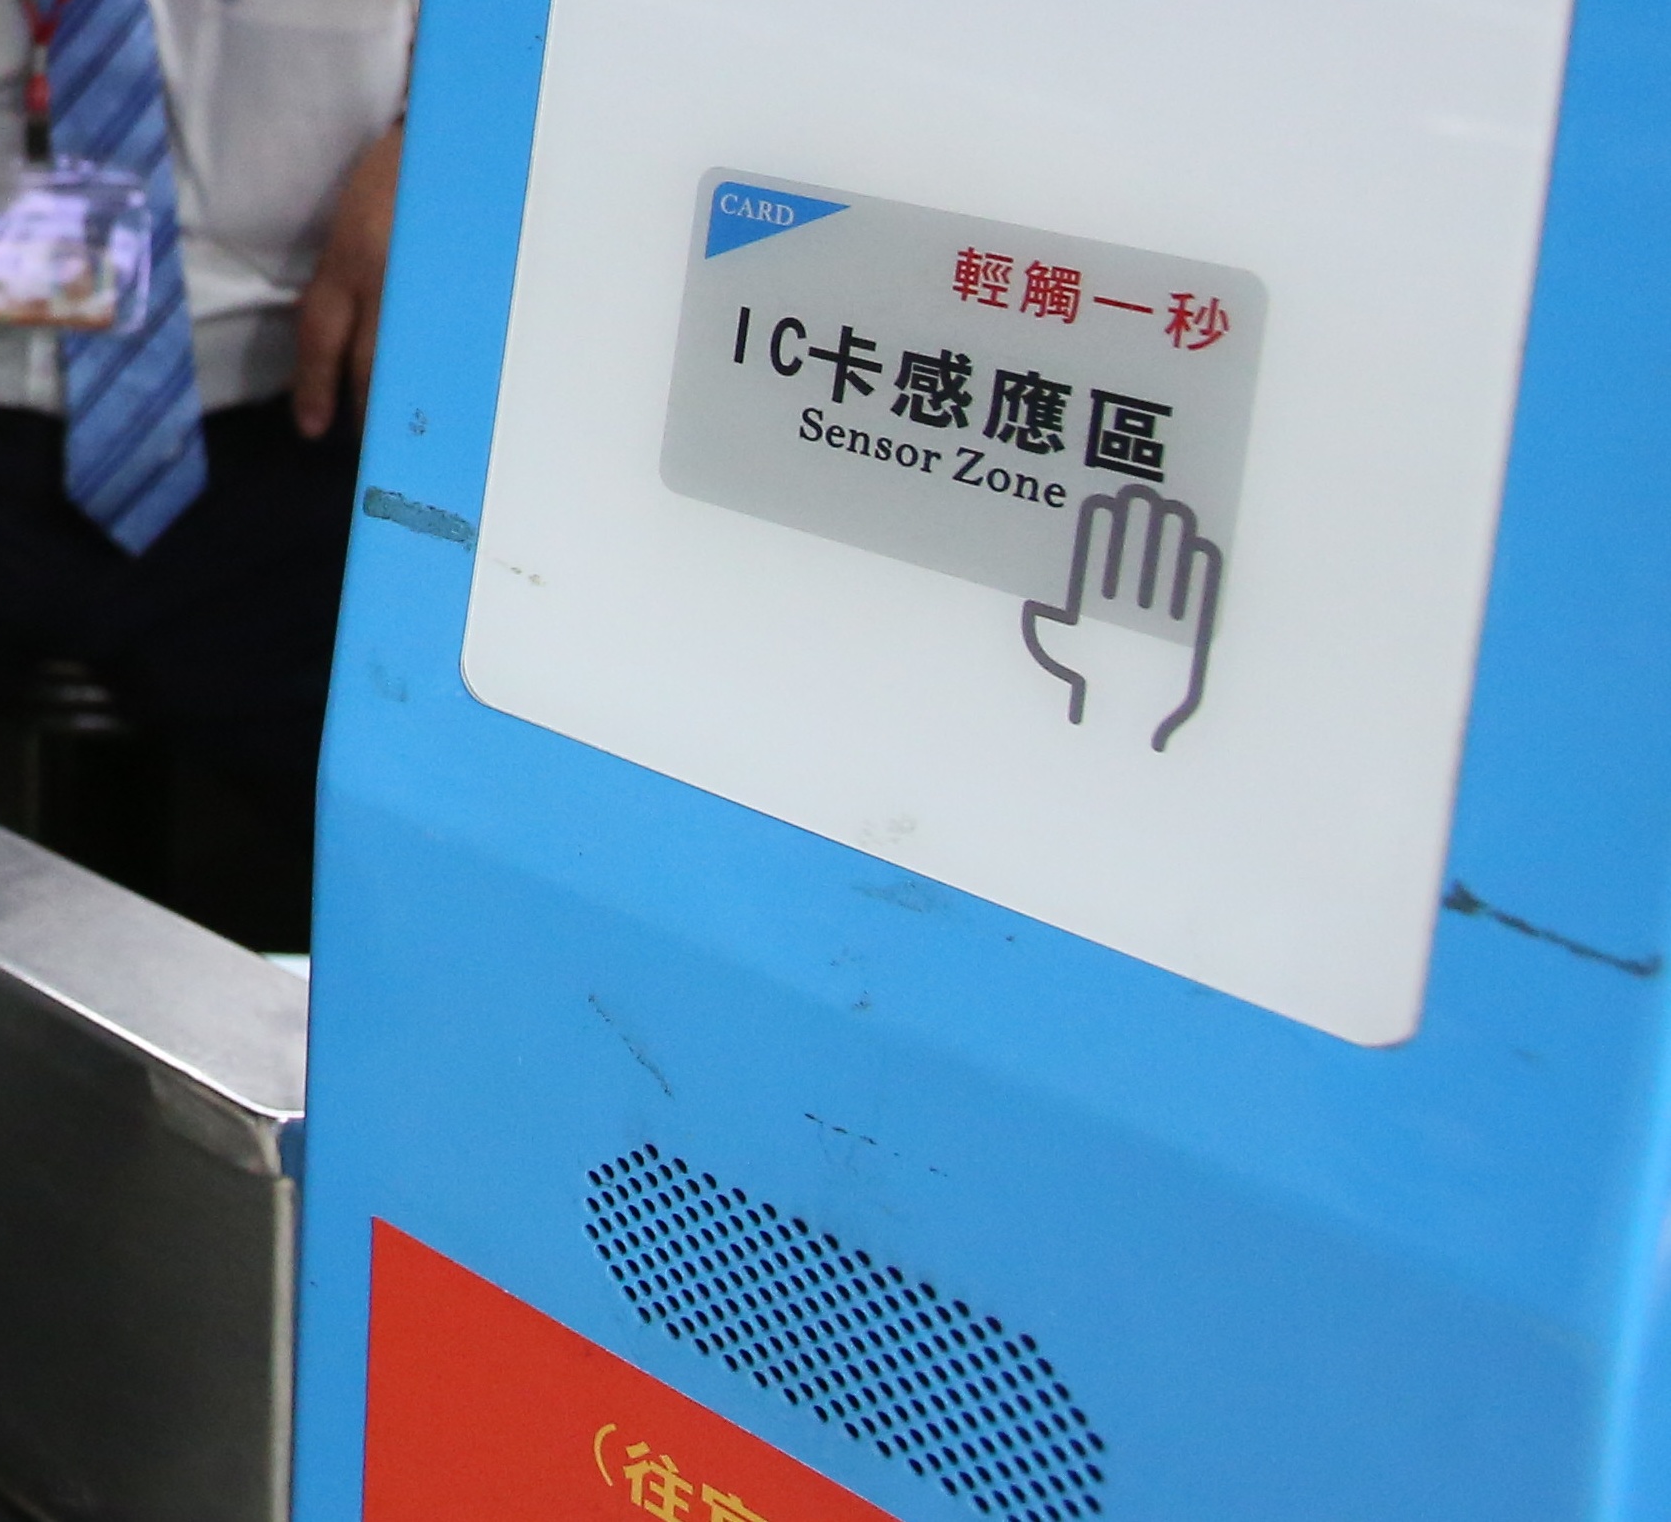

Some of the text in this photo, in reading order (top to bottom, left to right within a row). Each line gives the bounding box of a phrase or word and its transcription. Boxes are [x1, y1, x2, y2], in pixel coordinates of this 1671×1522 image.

[719, 192, 795, 226] CARD
[952, 246, 1229, 352] 輕觸一秒
[799, 406, 1068, 509] Sensor Zone
